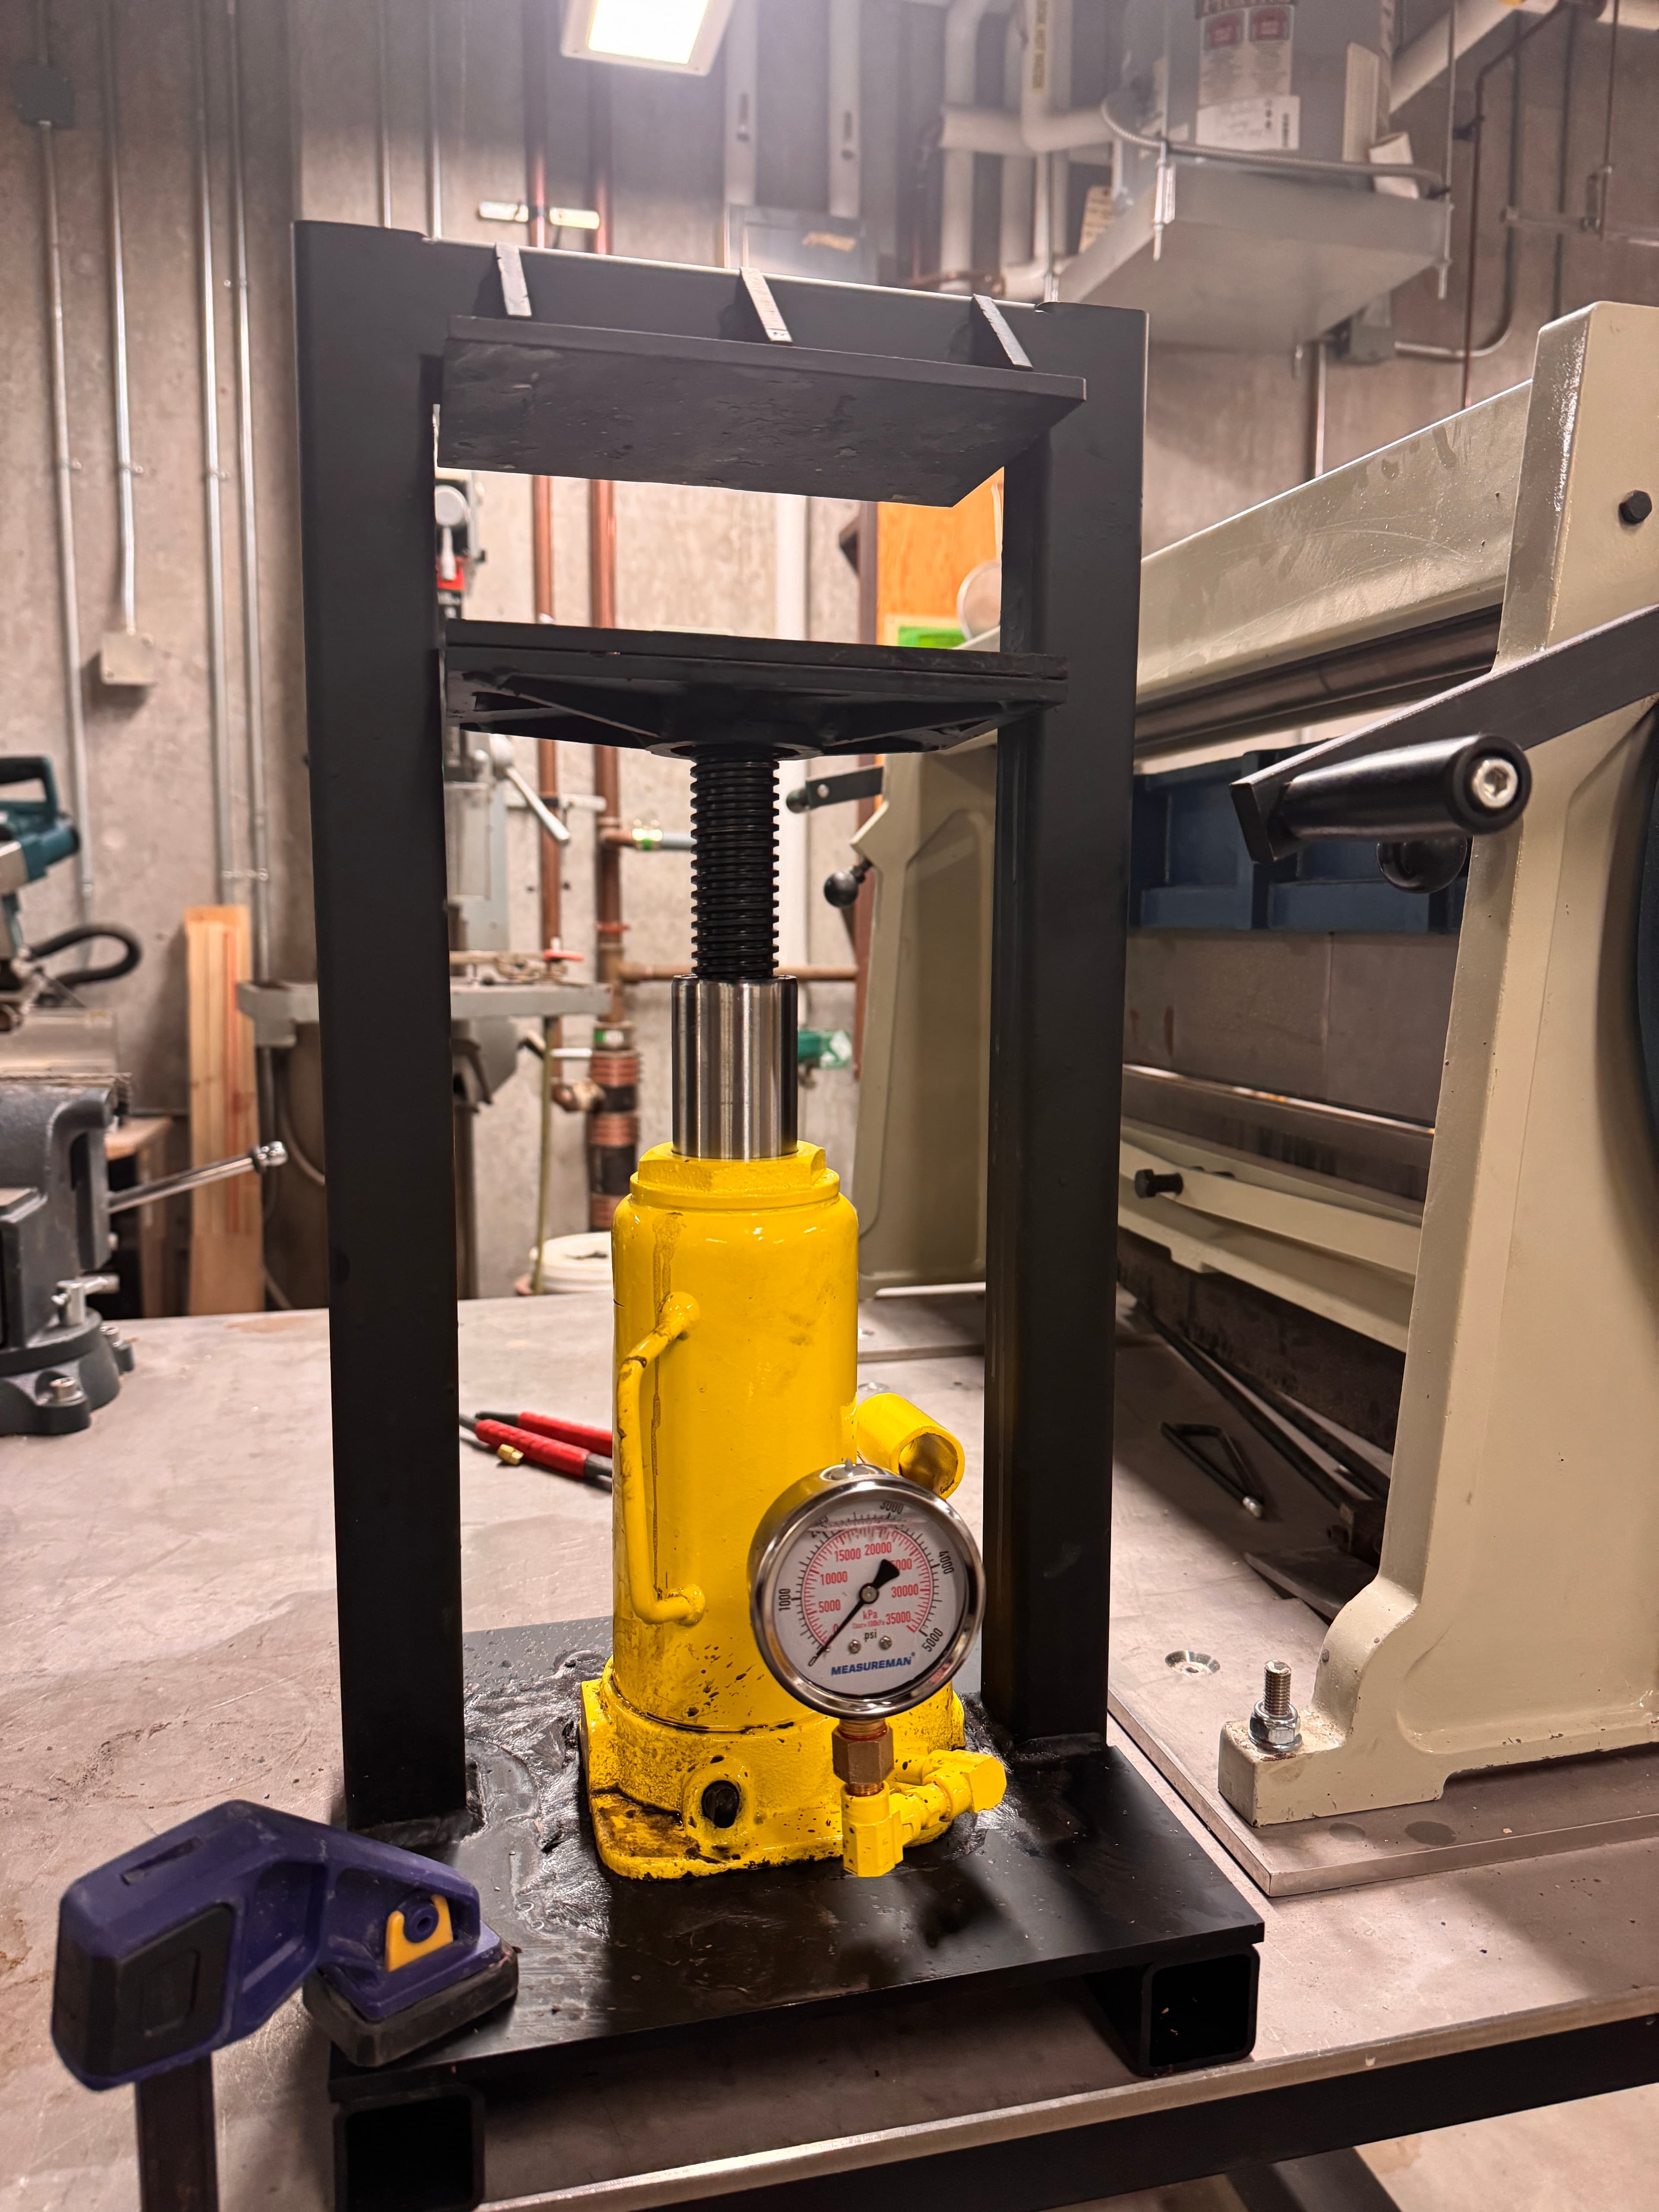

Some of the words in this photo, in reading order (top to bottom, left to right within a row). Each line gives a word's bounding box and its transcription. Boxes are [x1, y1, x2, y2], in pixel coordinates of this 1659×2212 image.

[880, 1500, 904, 1514] 3000
[835, 1548, 861, 1562] 15000
[864, 1541, 892, 1556] 20000
[939, 1551, 954, 1574] 4000
[821, 1571, 848, 1585] 10000
[891, 1584, 918, 1598] 30000
[779, 1588, 791, 1611] 1000
[819, 1599, 841, 1613] 5000
[863, 1610, 877, 1620] kPa
[886, 1611, 911, 1625] 35000
[864, 1629, 877, 1642] psi
[922, 1627, 944, 1652] 5000
[807, 1655, 817, 1667] 0
[830, 1656, 912, 1676] MEASUREMAN
